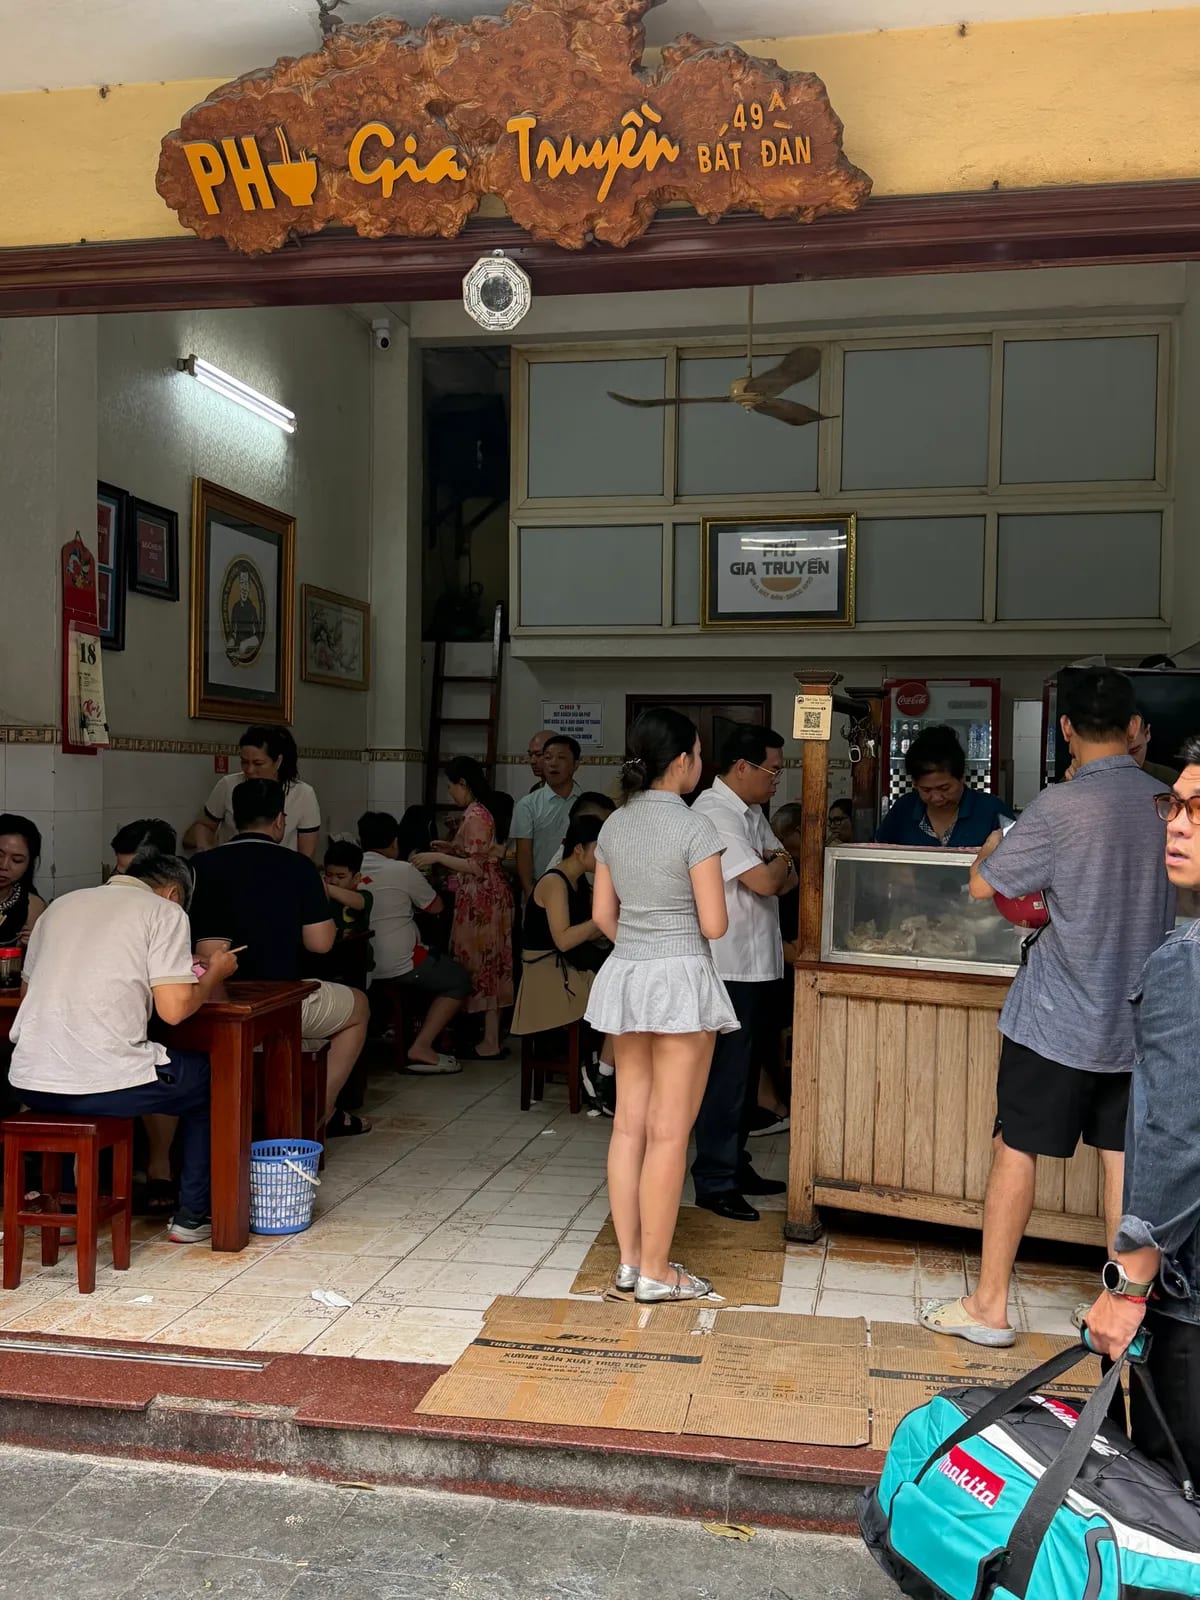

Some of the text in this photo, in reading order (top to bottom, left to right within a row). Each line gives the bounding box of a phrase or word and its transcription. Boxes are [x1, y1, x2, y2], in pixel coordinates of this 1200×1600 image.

[349, 123, 467, 199] Gia
[507, 103, 680, 202] Truyền
[698, 122, 742, 173] BÁT
[730, 562, 756, 576] GIA
[80, 643, 97, 665] 18
[938, 1454, 994, 1510] makita
